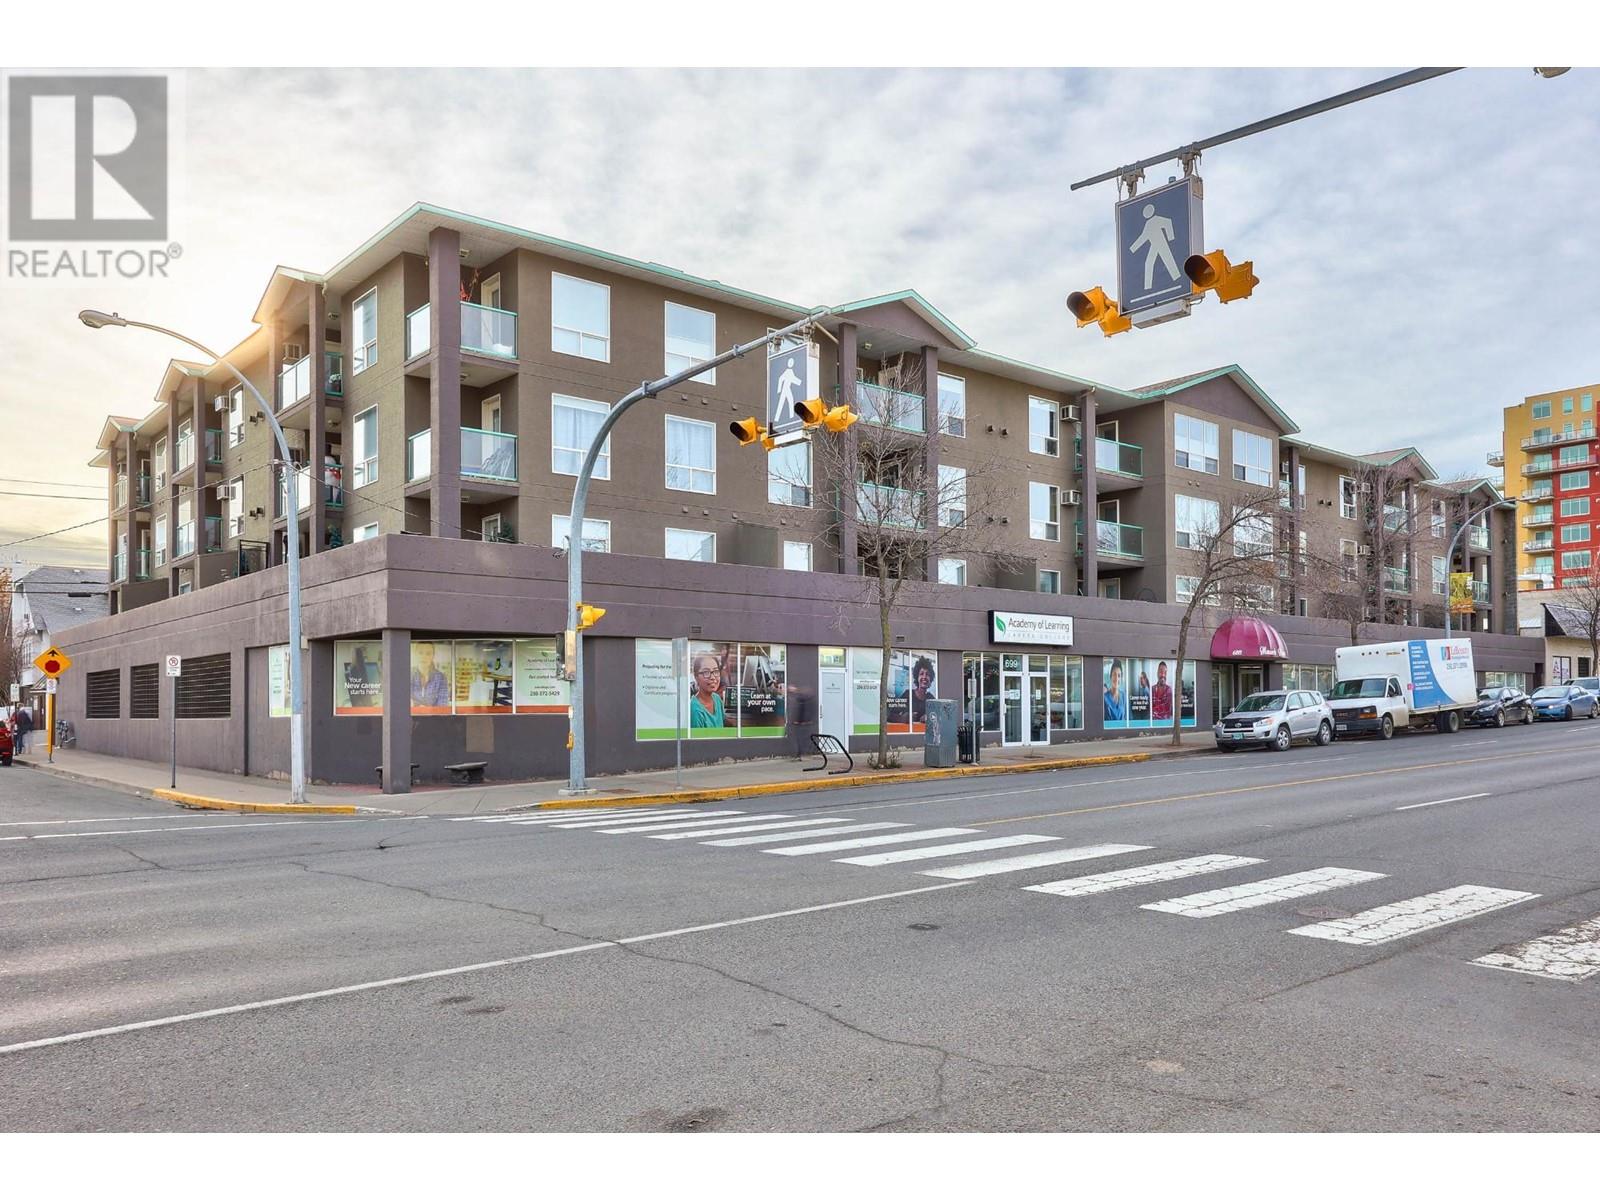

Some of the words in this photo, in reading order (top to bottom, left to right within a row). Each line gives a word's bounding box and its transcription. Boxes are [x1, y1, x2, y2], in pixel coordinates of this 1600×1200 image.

[1008, 617, 1036, 631] Academy
[1037, 620, 1044, 629] of
[1045, 620, 1070, 633] Learning
[1005, 659, 1018, 668] 699
[747, 699, 761, 707] your
[761, 706, 775, 714] pace.
